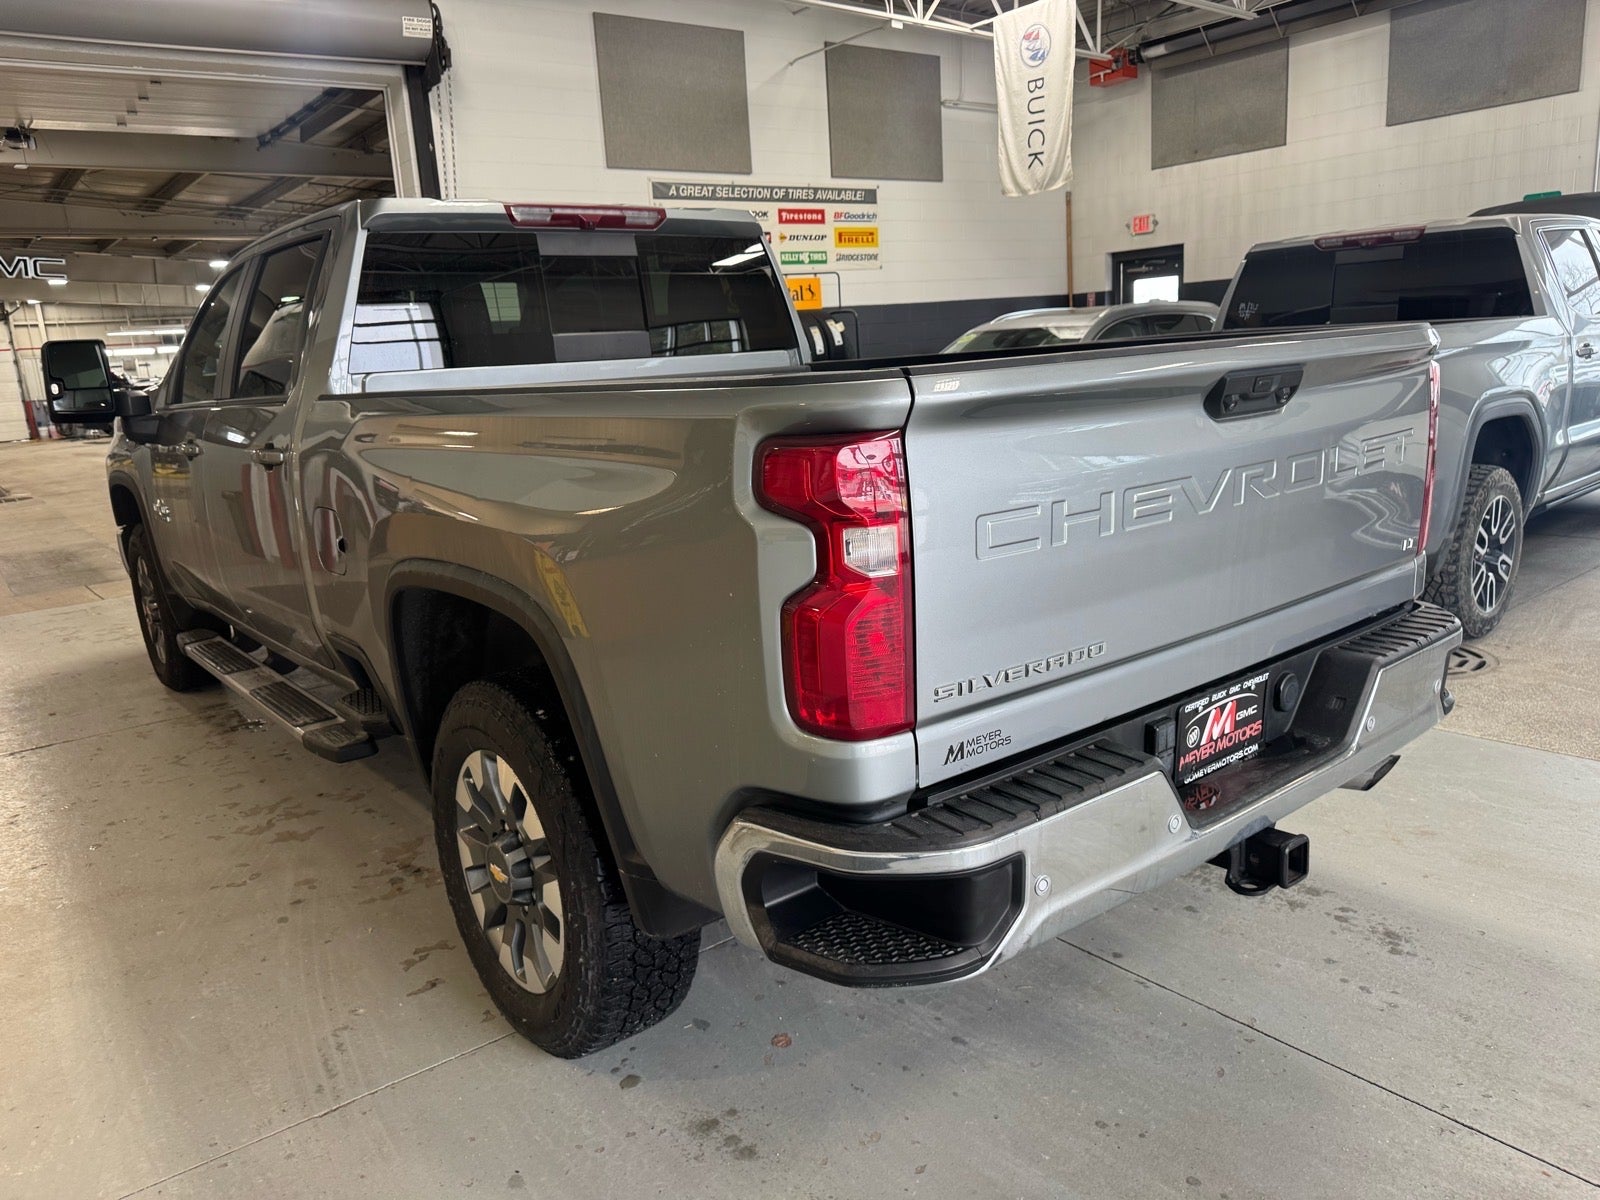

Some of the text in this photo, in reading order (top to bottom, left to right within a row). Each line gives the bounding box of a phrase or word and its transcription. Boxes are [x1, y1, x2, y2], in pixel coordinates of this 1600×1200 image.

[1027, 77, 1045, 170] BUICK
[669, 185, 865, 201] A GREAT SELECTION OF TIRES AVAILABLE!
[781, 211, 822, 221] Firestone
[834, 211, 877, 220] BFGoodrich
[1133, 215, 1149, 232] EXIT
[838, 231, 875, 243] PIRELLI
[781, 252, 799, 261] KELLY
[809, 252, 827, 261] TIRES
[836, 253, 879, 262] BRIDGESTONE
[788, 285, 804, 301] al
[975, 427, 1414, 560] CHEVROLET
[933, 640, 1107, 703] SILVERADO
[1211, 689, 1228, 702] BUICK
[1228, 684, 1242, 695] GMC
[1236, 705, 1258, 720] GMC
[966, 729, 1002, 748] MEYER
[1179, 720, 1262, 771] MEYER MOTORS
[966, 735, 1012, 759] MOTORS
